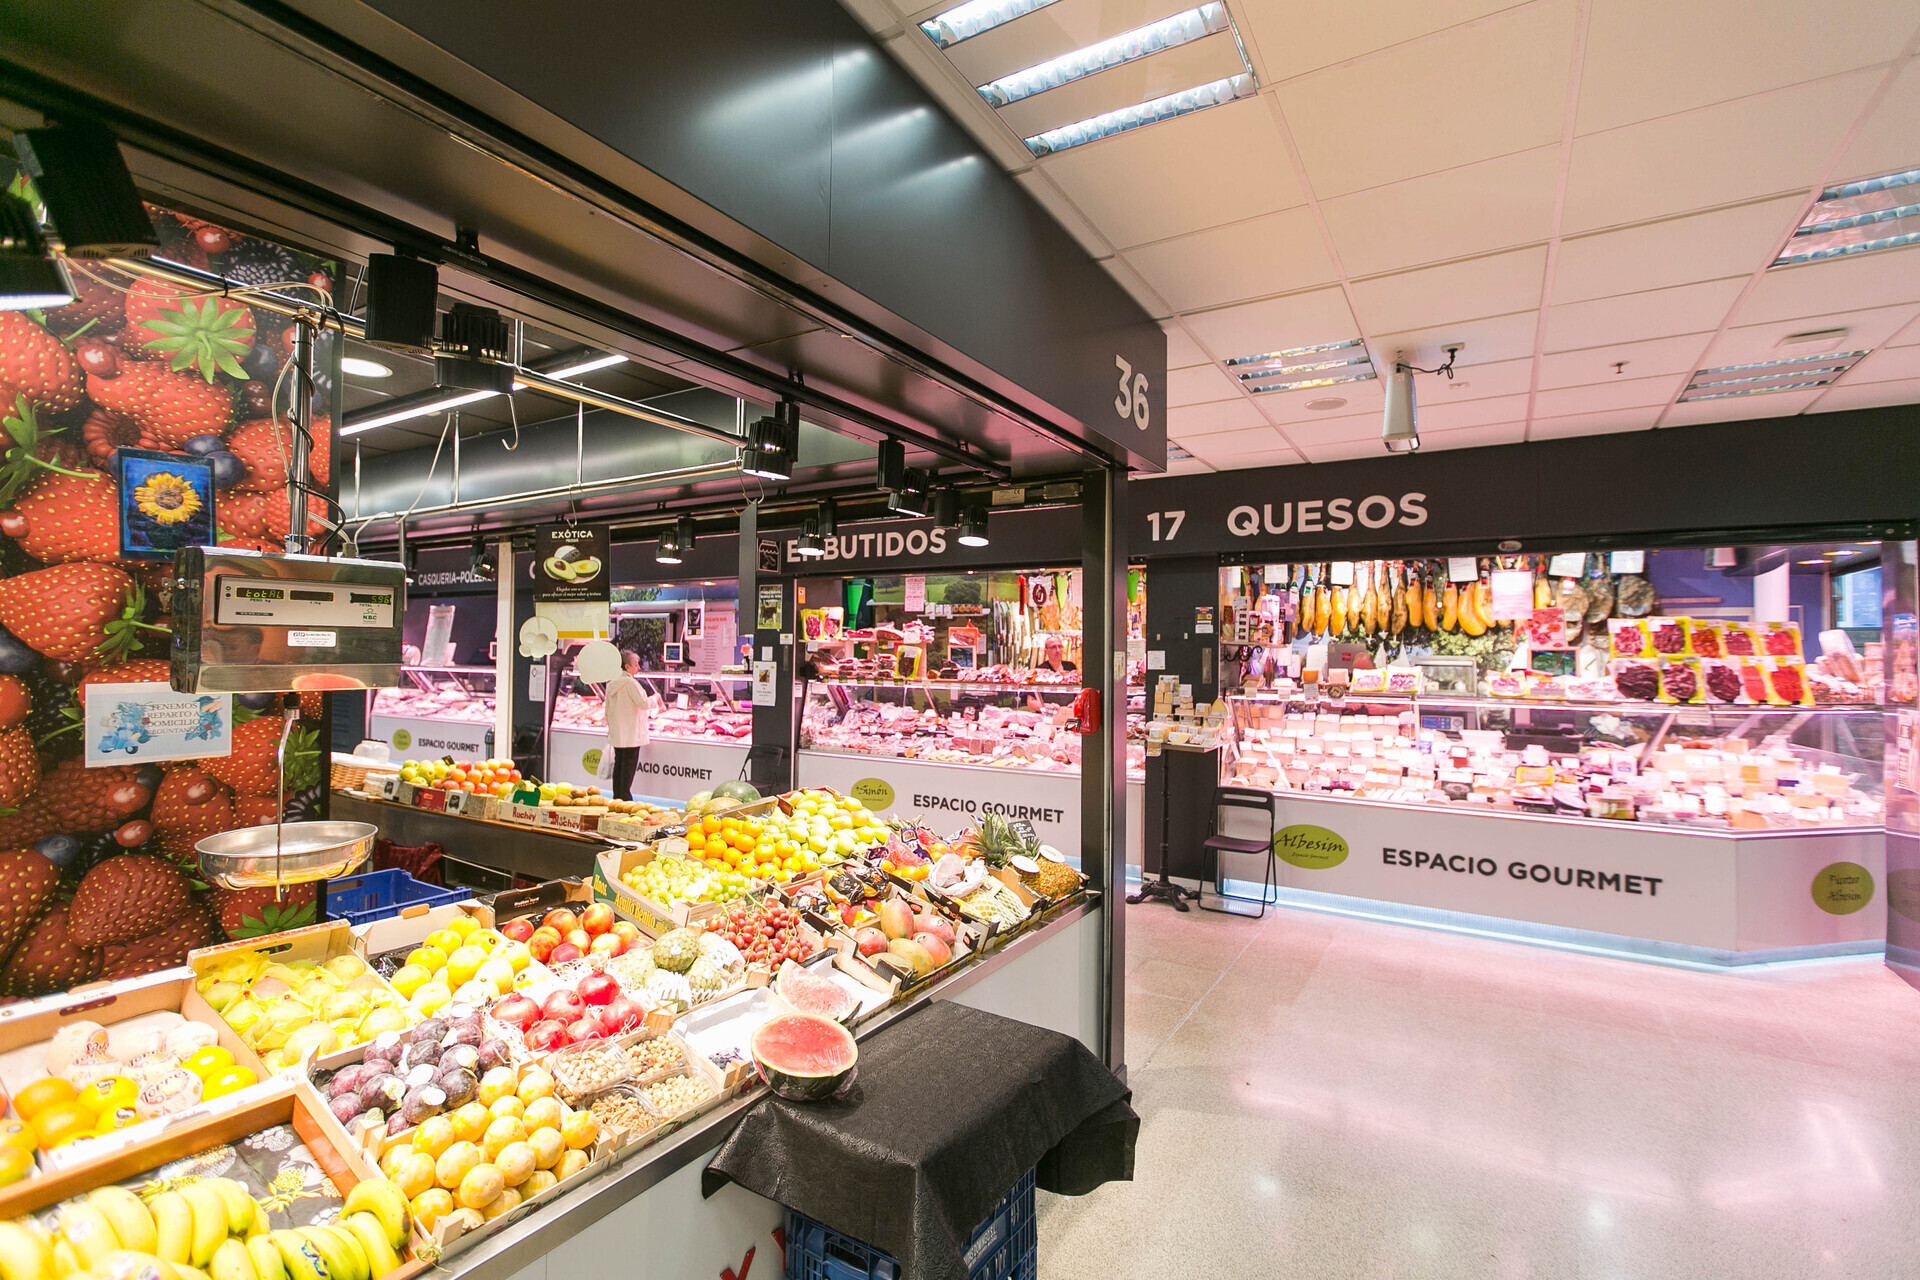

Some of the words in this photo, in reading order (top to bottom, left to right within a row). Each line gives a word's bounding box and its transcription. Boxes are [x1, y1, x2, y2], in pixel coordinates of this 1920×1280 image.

[1114, 354, 1150, 431] 36
[1226, 492, 1429, 537] QUESOS
[551, 529, 594, 539] EXÓTICA
[1146, 509, 1186, 542] 17
[147, 711, 192, 719] REPARTO
[149, 702, 198, 711] TENEMOS
[147, 718, 200, 728] DOMICILIO
[418, 737, 445, 750] ESPACIO
[446, 740, 480, 753] GOURMET
[636, 762, 660, 774] ACIO
[663, 764, 712, 781] GOURMET
[913, 793, 977, 813] ESPACIO
[981, 801, 1064, 824] GOURMET
[1274, 832, 1345, 852] Albesim
[1382, 846, 1498, 876] ESPACIO
[1508, 861, 1663, 898] GOURMET
